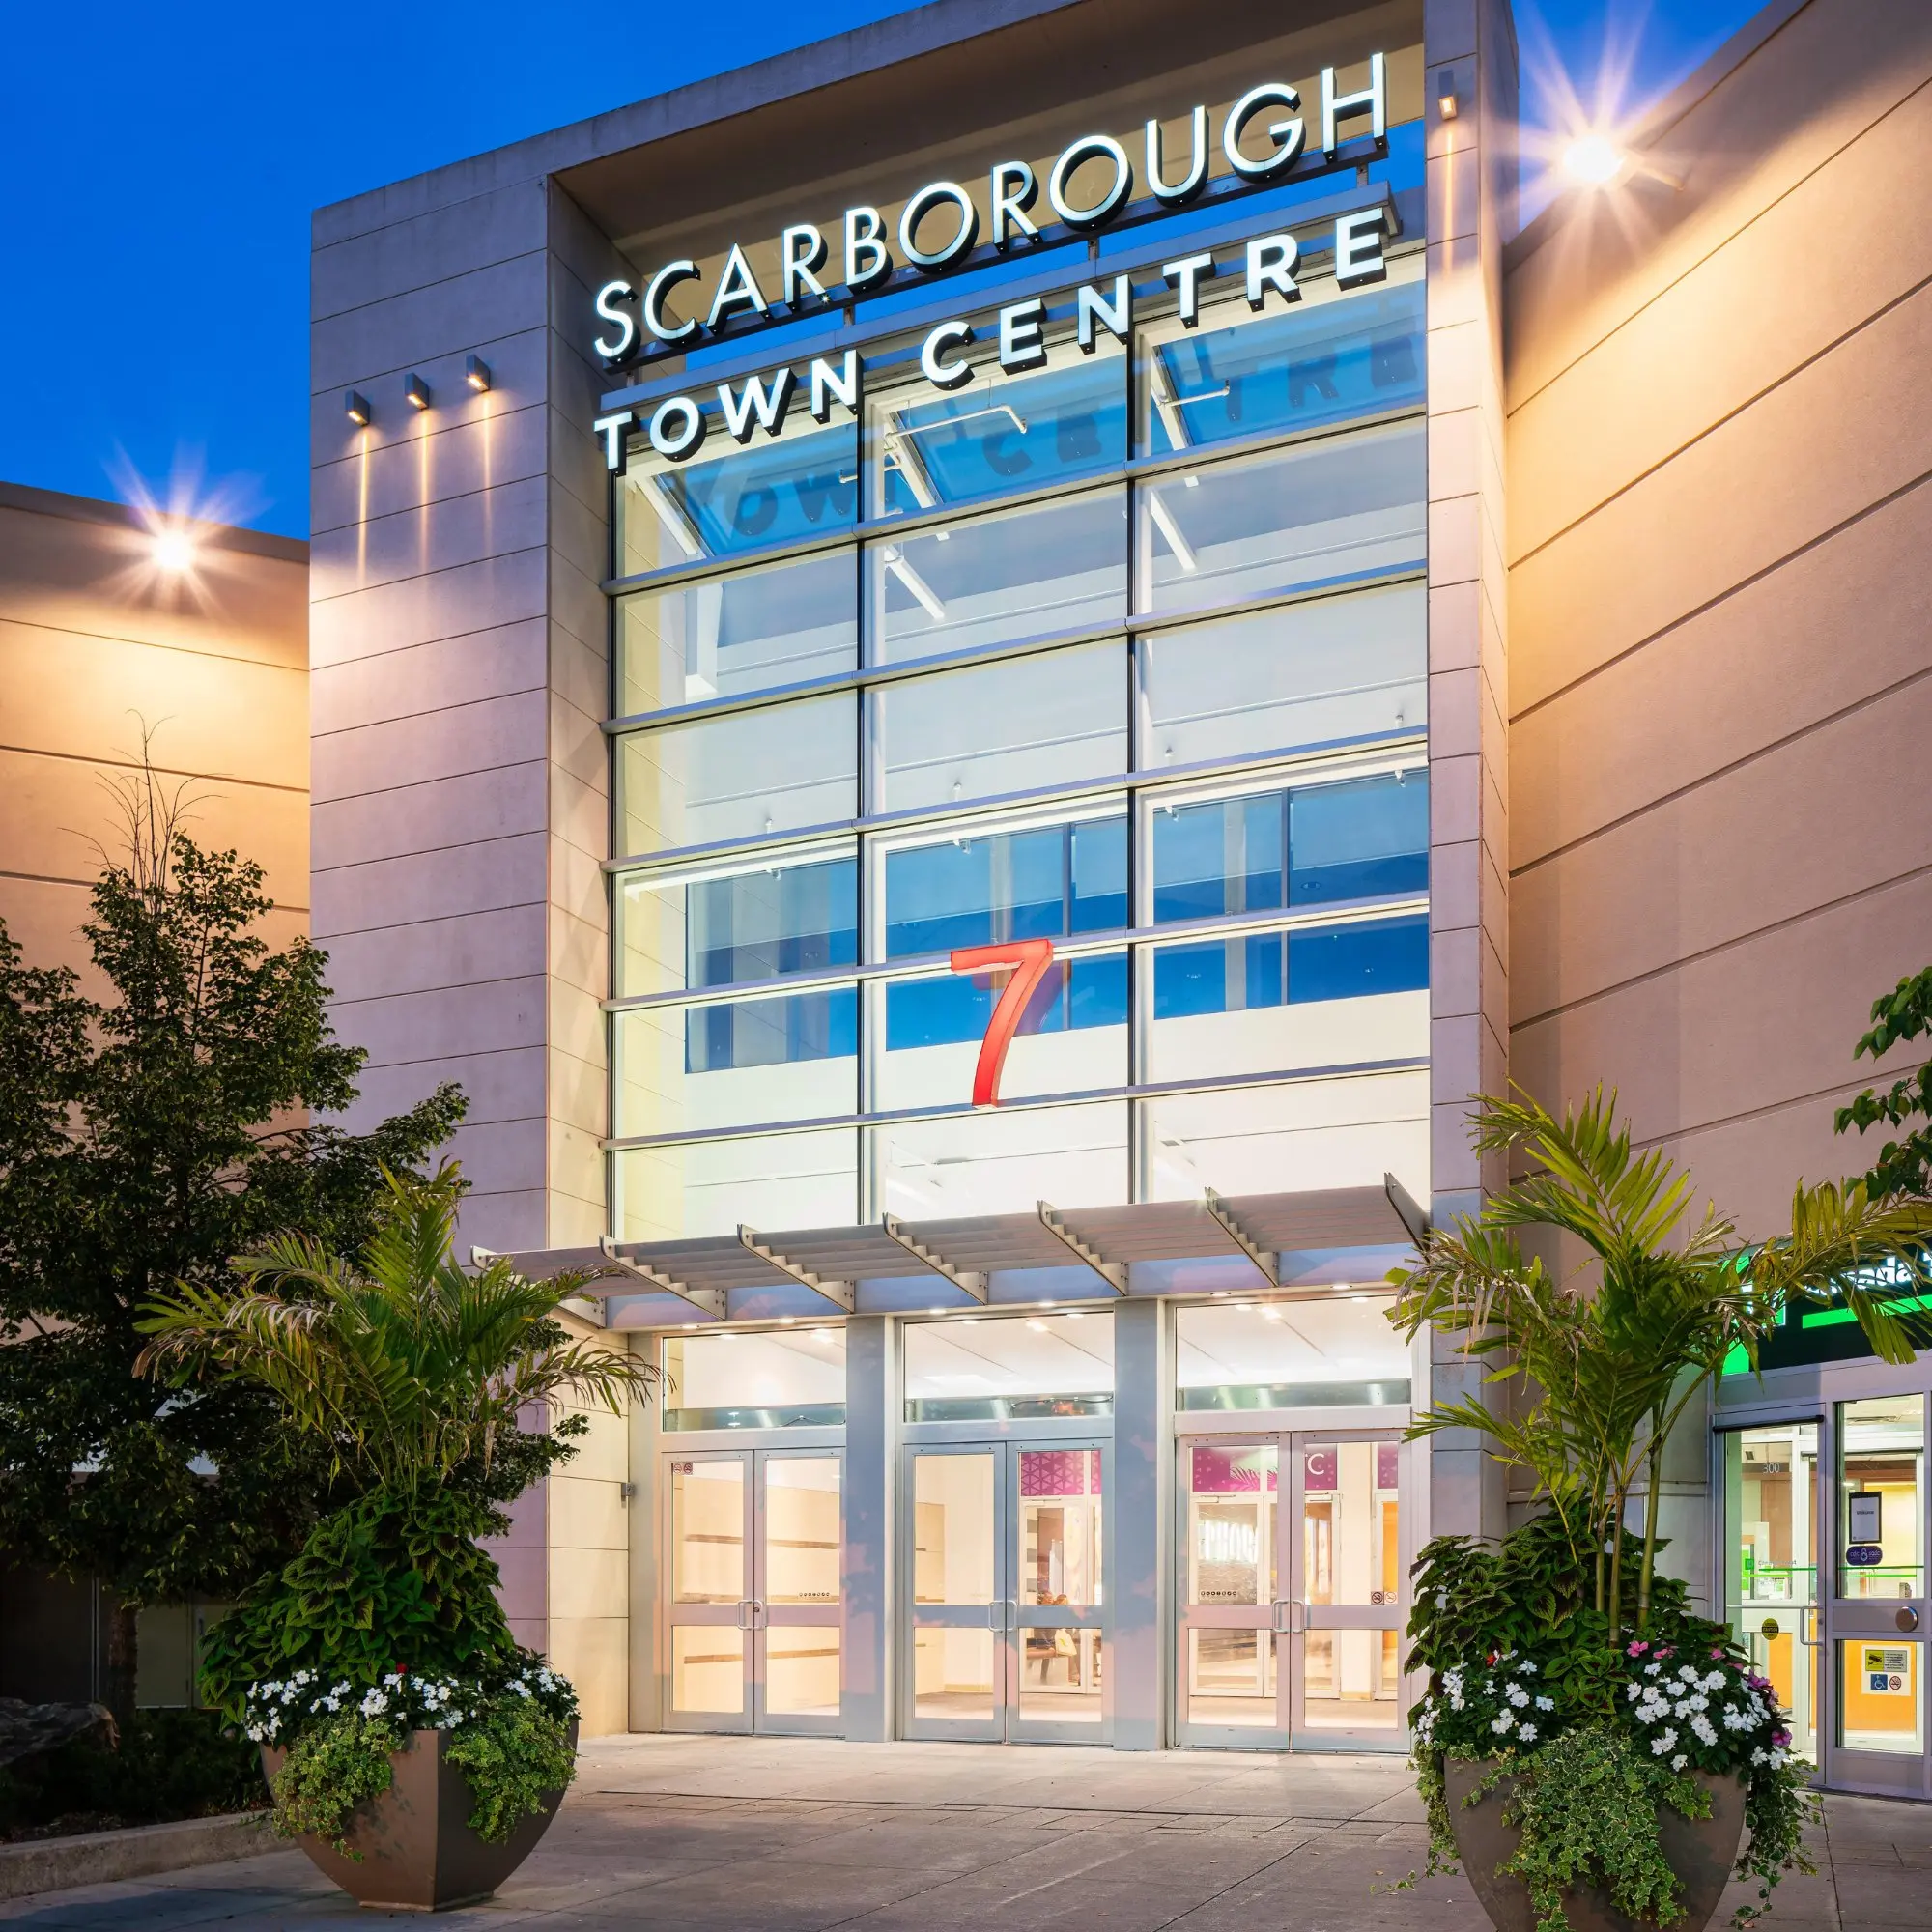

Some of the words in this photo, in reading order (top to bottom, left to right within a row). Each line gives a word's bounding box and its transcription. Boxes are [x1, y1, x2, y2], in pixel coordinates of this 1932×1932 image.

[595, 52, 1387, 363] SCARBOROUGH
[594, 349, 864, 471] TOWN
[922, 208, 1387, 390] CENTRE
[951, 938, 1054, 1109] 7
[1305, 1453, 1325, 1475] C
[1763, 1462, 1780, 1474] 300
